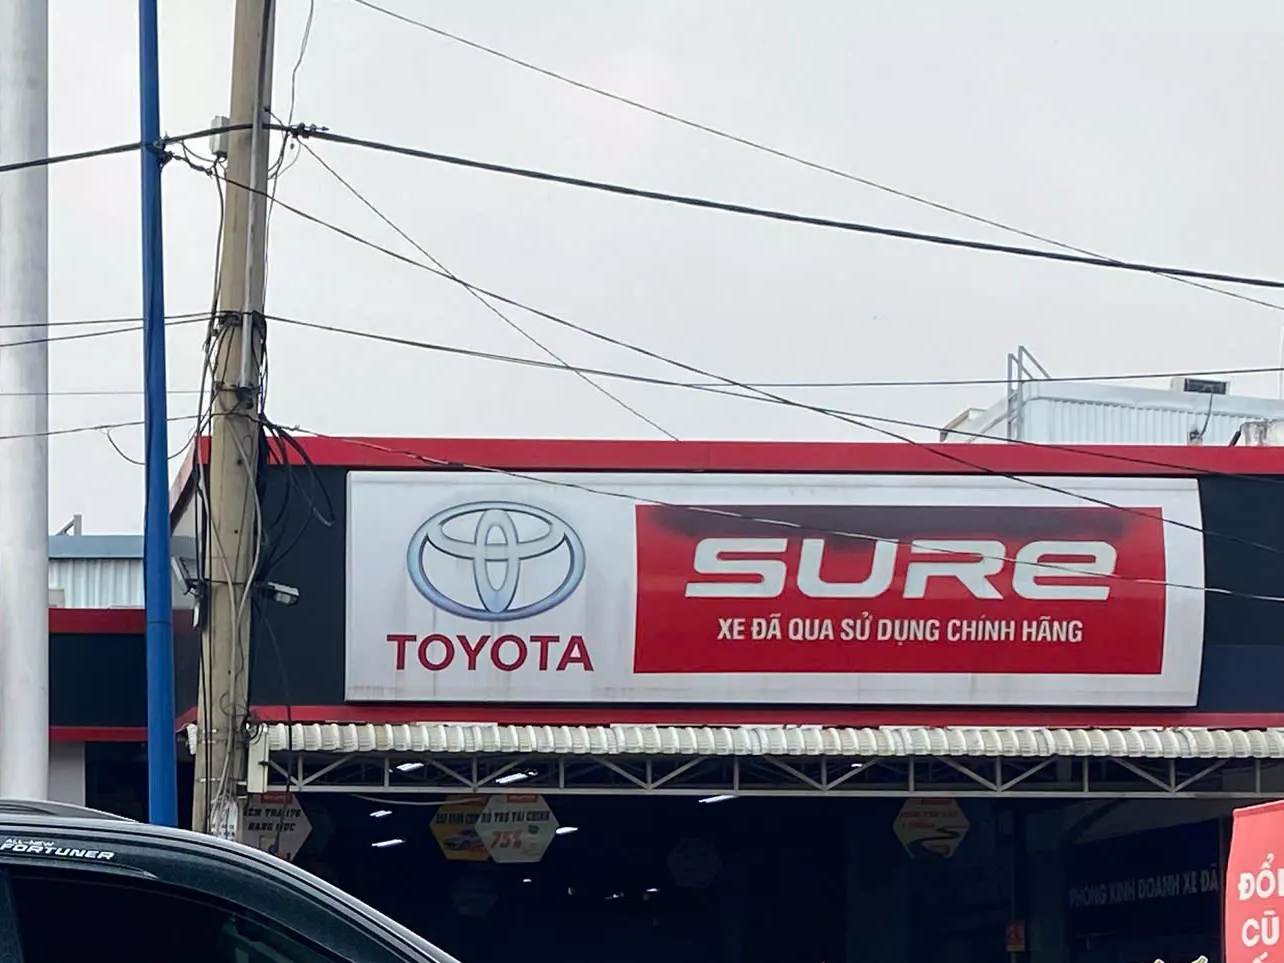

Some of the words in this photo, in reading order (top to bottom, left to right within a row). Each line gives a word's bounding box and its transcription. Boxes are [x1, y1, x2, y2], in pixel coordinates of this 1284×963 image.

[716, 617, 746, 640] XE
[751, 612, 783, 640] ĐÃ
[788, 618, 835, 641] QUA
[840, 610, 873, 641] SỬ
[877, 618, 940, 647] DỤNG
[947, 614, 1015, 642] CHÍNH
[1021, 615, 1084, 643] HÃNG
[386, 633, 595, 672] TOYOTA
[0, 843, 116, 861] FORTUNER
[1240, 909, 1281, 948] CŨ
